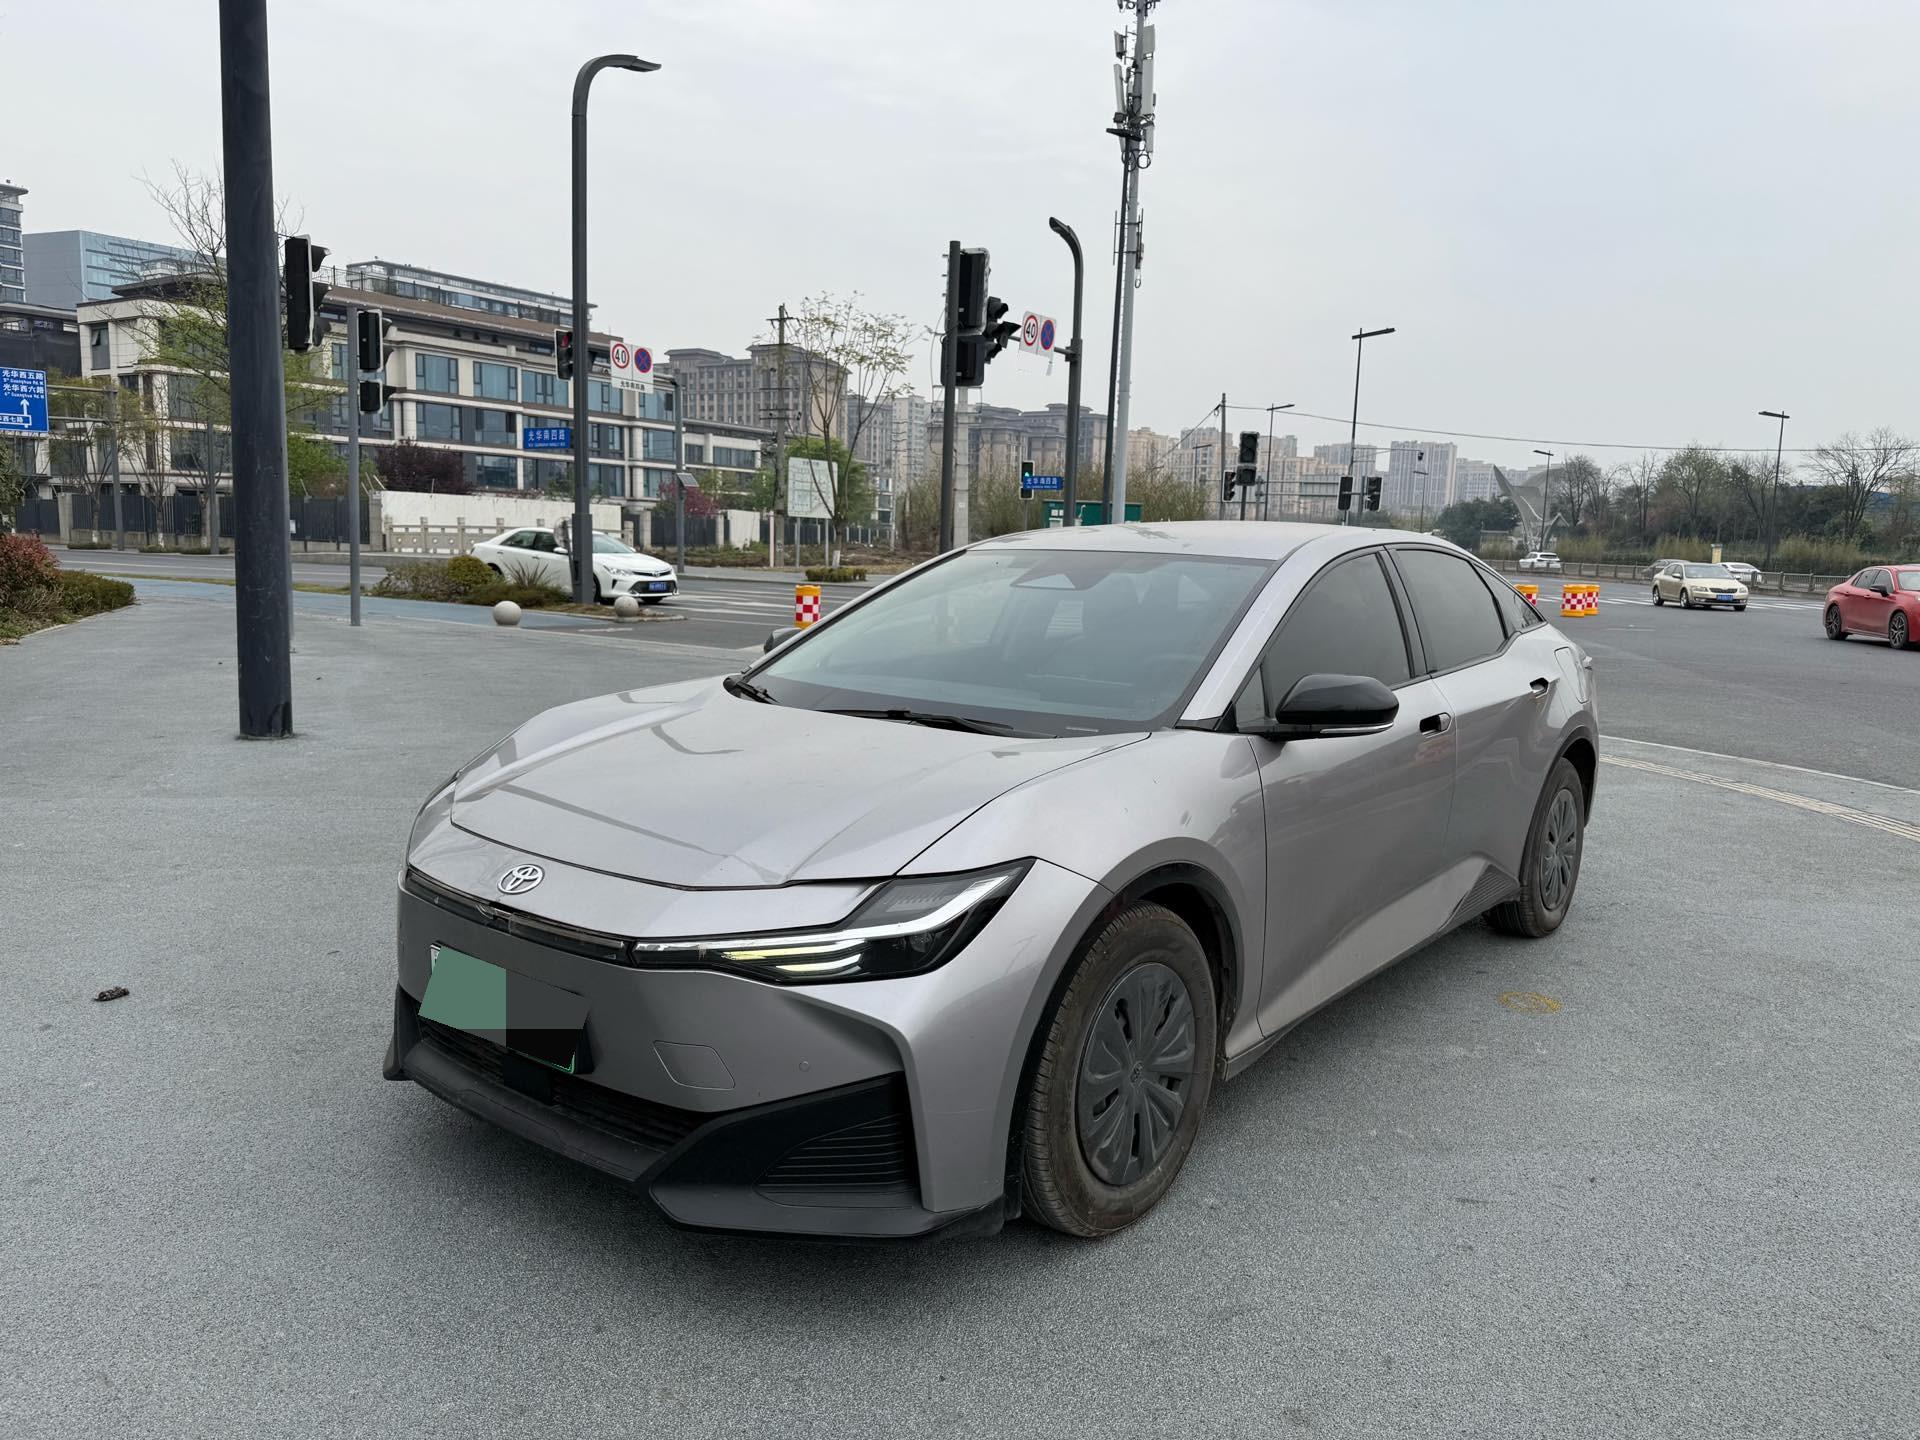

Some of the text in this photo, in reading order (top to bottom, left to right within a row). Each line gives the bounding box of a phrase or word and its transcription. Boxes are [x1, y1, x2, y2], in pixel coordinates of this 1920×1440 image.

[1025, 322, 1036, 338] 40
[615, 349, 627, 364] 40
[2, 370, 44, 380] 光华西五路
[3, 383, 44, 394] 光华西六路
[528, 429, 565, 441] 光华南四路
